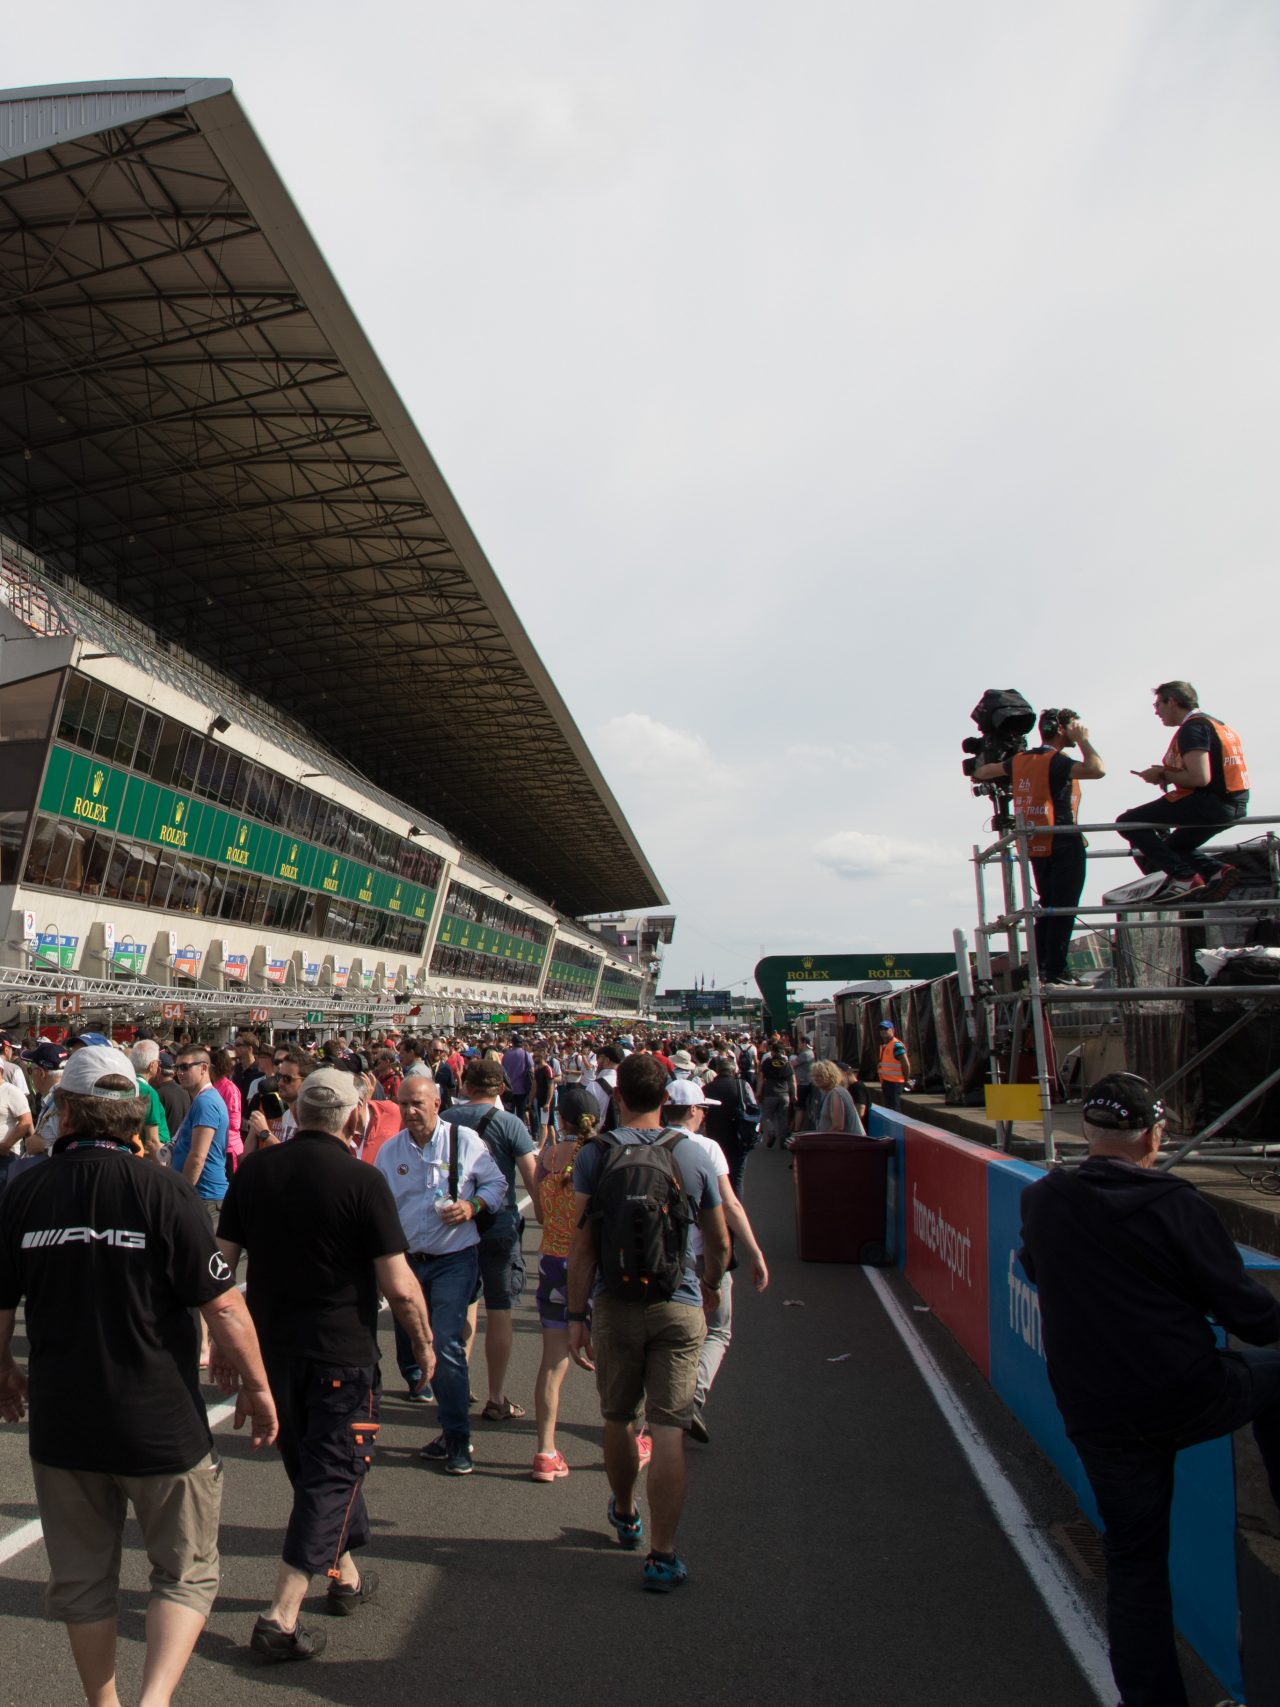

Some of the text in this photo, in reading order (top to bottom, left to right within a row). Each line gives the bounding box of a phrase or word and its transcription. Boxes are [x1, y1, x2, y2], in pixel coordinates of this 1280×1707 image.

[73, 797, 109, 823] ROLEX
[160, 825, 189, 847] ROLEX
[226, 846, 250, 865] ROLEX
[280, 863, 299, 880] ROLEX
[787, 968, 912, 980] ROLEX ROLEX
[164, 1006, 181, 1019] 54
[253, 1009, 268, 1021] 70
[310, 1011, 322, 1022] 71
[355, 1014, 367, 1024] 51
[393, 1014, 405, 1024] 57
